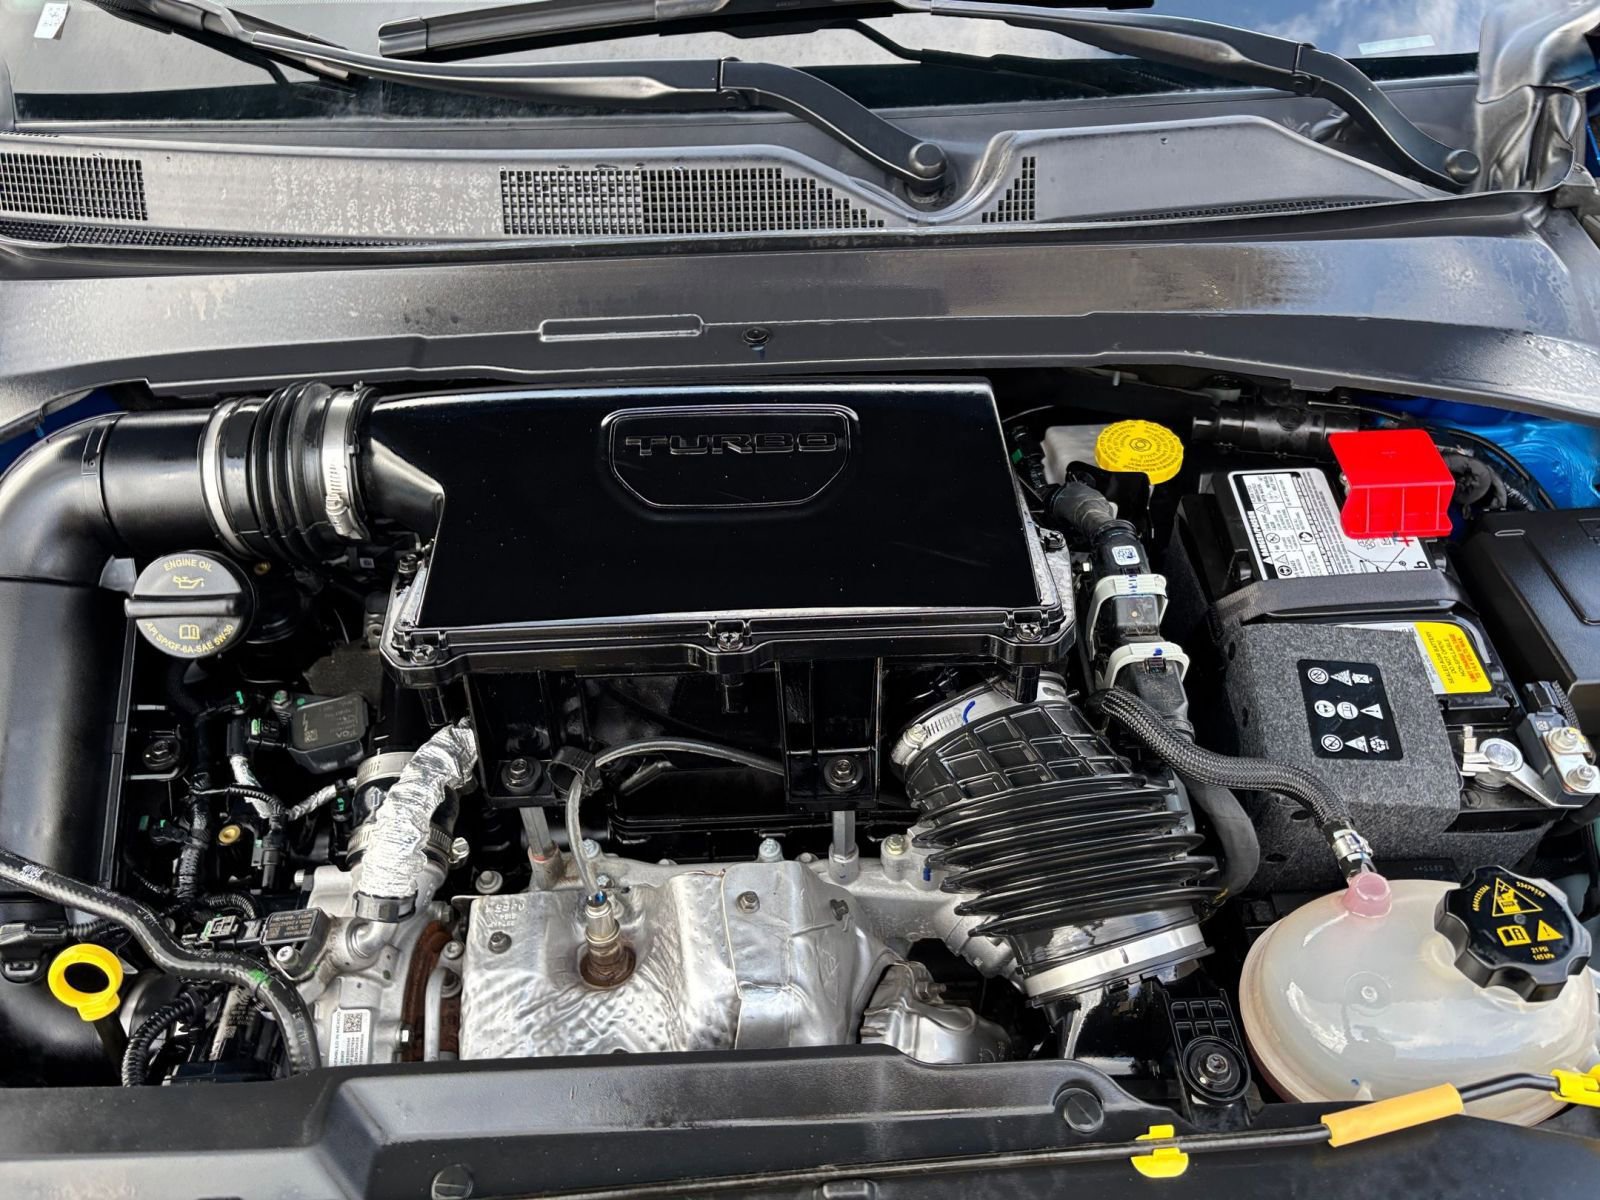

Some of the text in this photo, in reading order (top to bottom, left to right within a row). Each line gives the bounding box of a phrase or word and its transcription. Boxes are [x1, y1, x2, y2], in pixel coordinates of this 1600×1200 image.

[625, 432, 837, 456] TURBO
[163, 558, 212, 572] ENGINE OIL
[145, 622, 158, 637] API
[213, 624, 234, 646] 5W-30
[1426, 631, 1439, 652] BATTERY
[1439, 664, 1454, 684] SEALED
